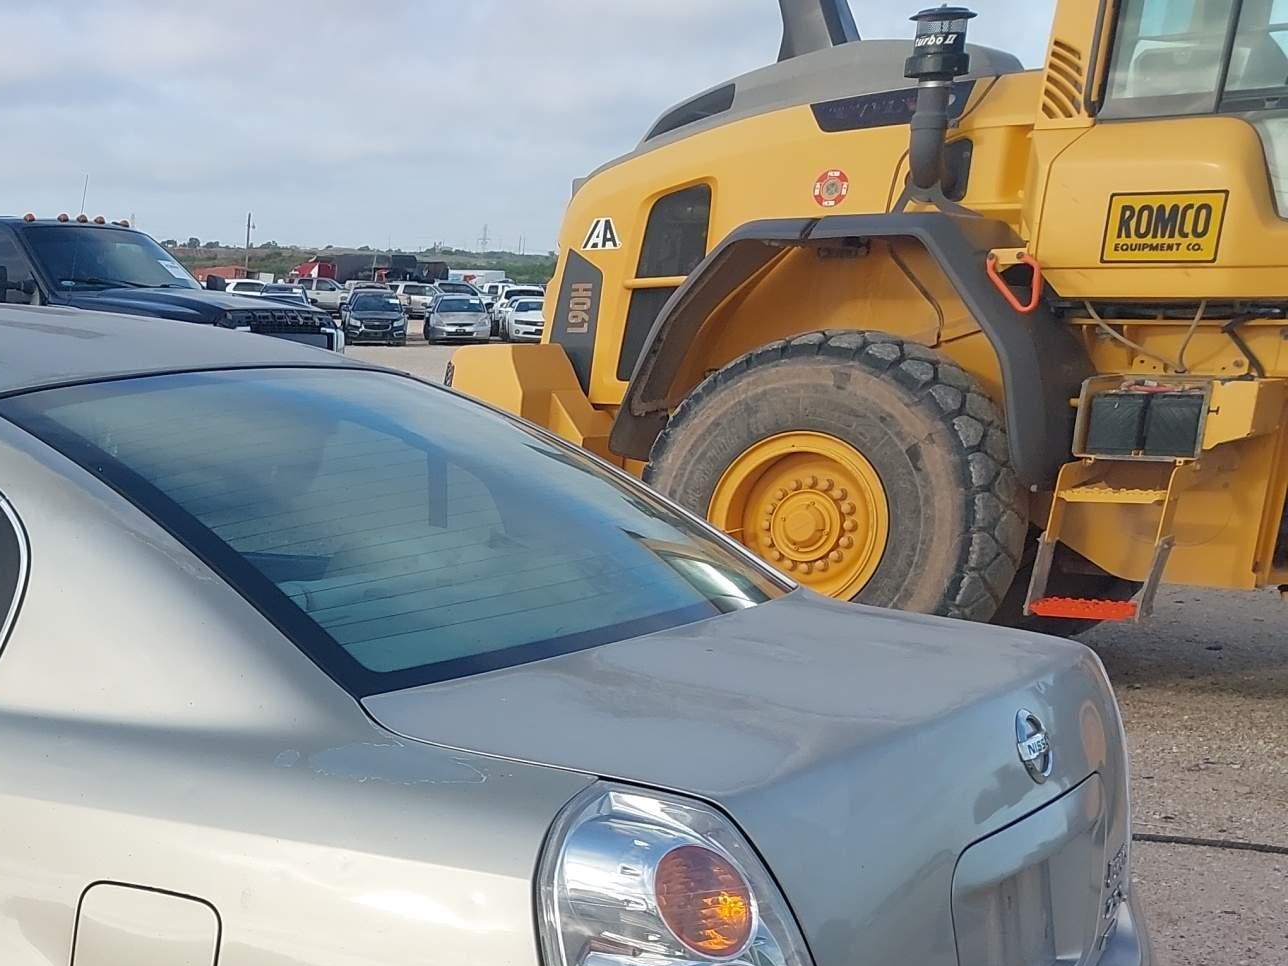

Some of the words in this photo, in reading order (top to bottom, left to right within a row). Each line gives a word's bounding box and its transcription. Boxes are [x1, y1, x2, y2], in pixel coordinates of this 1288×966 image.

[915, 34, 944, 48] turbo
[1116, 203, 1213, 239] ROMCO
[1113, 242, 1182, 252] EQUIPMENT
[1186, 242, 1204, 252] CO.
[567, 283, 593, 334] L90H
